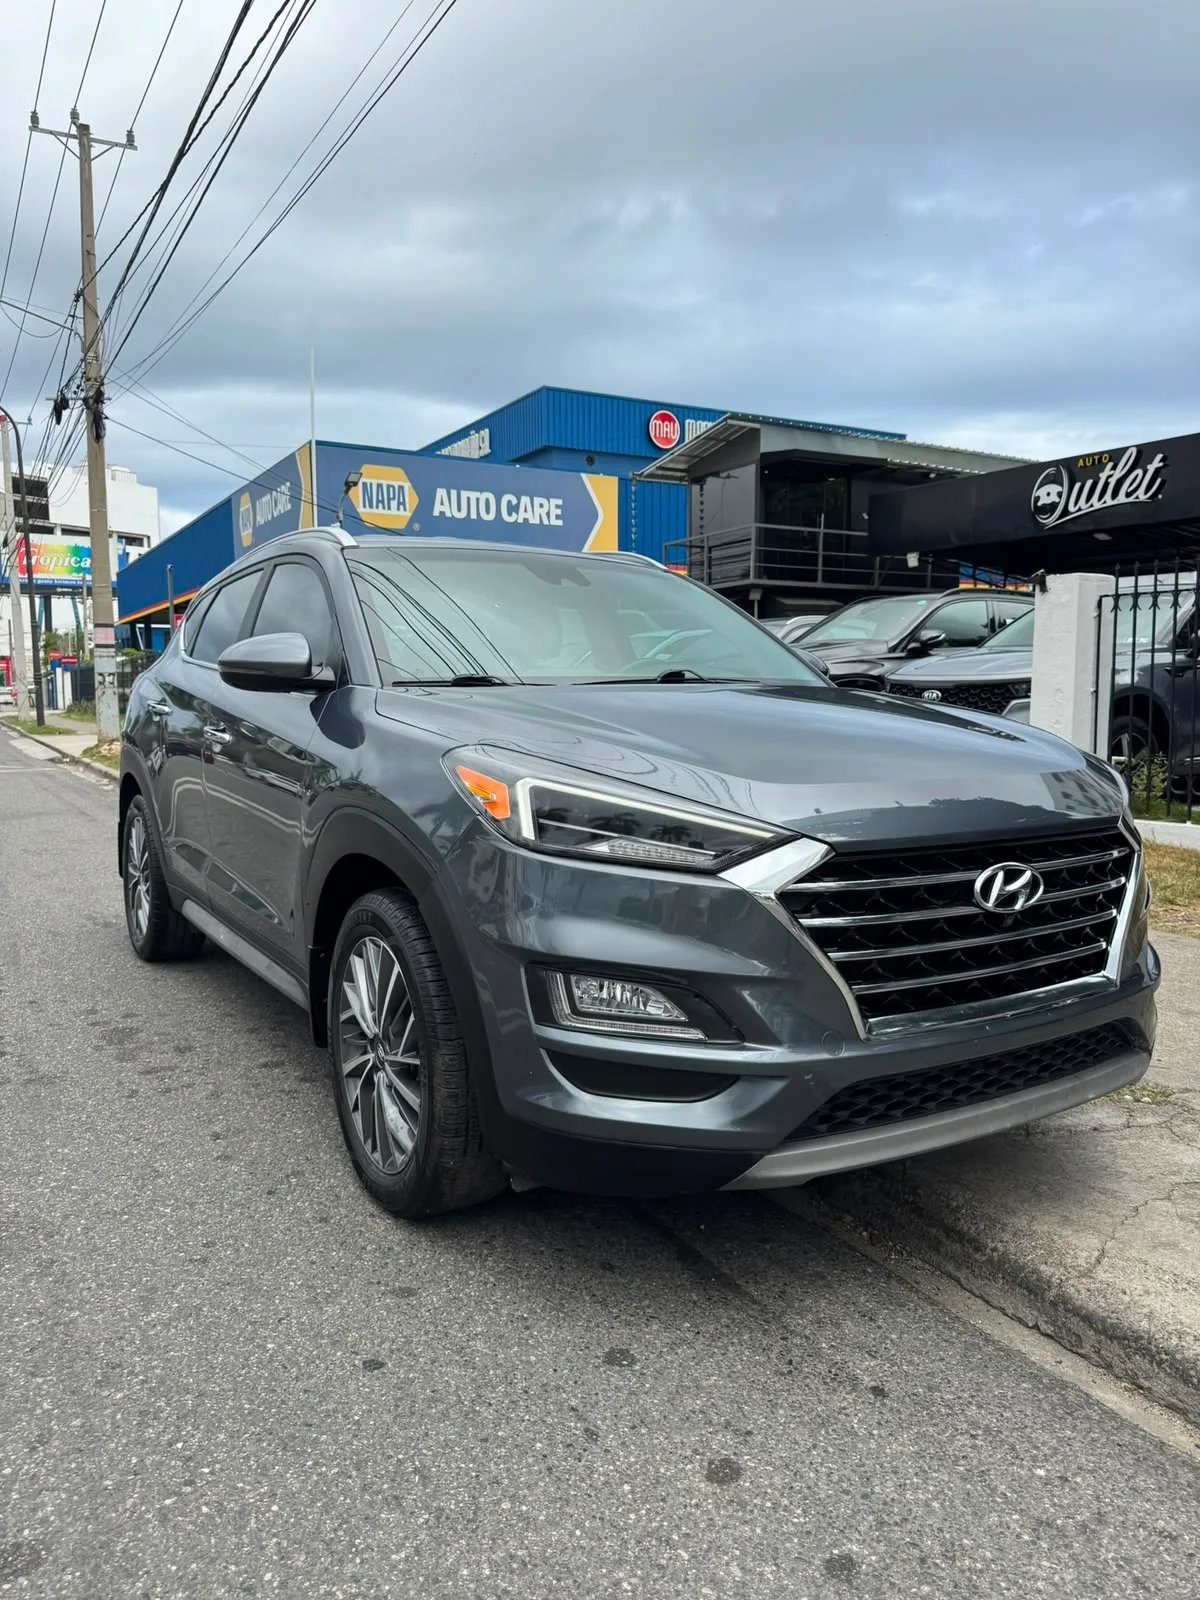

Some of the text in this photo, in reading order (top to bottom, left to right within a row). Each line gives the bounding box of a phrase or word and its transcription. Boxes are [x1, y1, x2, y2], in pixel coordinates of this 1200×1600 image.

[653, 419, 677, 440] MAU
[1077, 453, 1110, 468] AUTO
[361, 481, 408, 512] NAPA
[433, 487, 563, 526] AUTO CARE
[20, 547, 91, 572] Tropica
